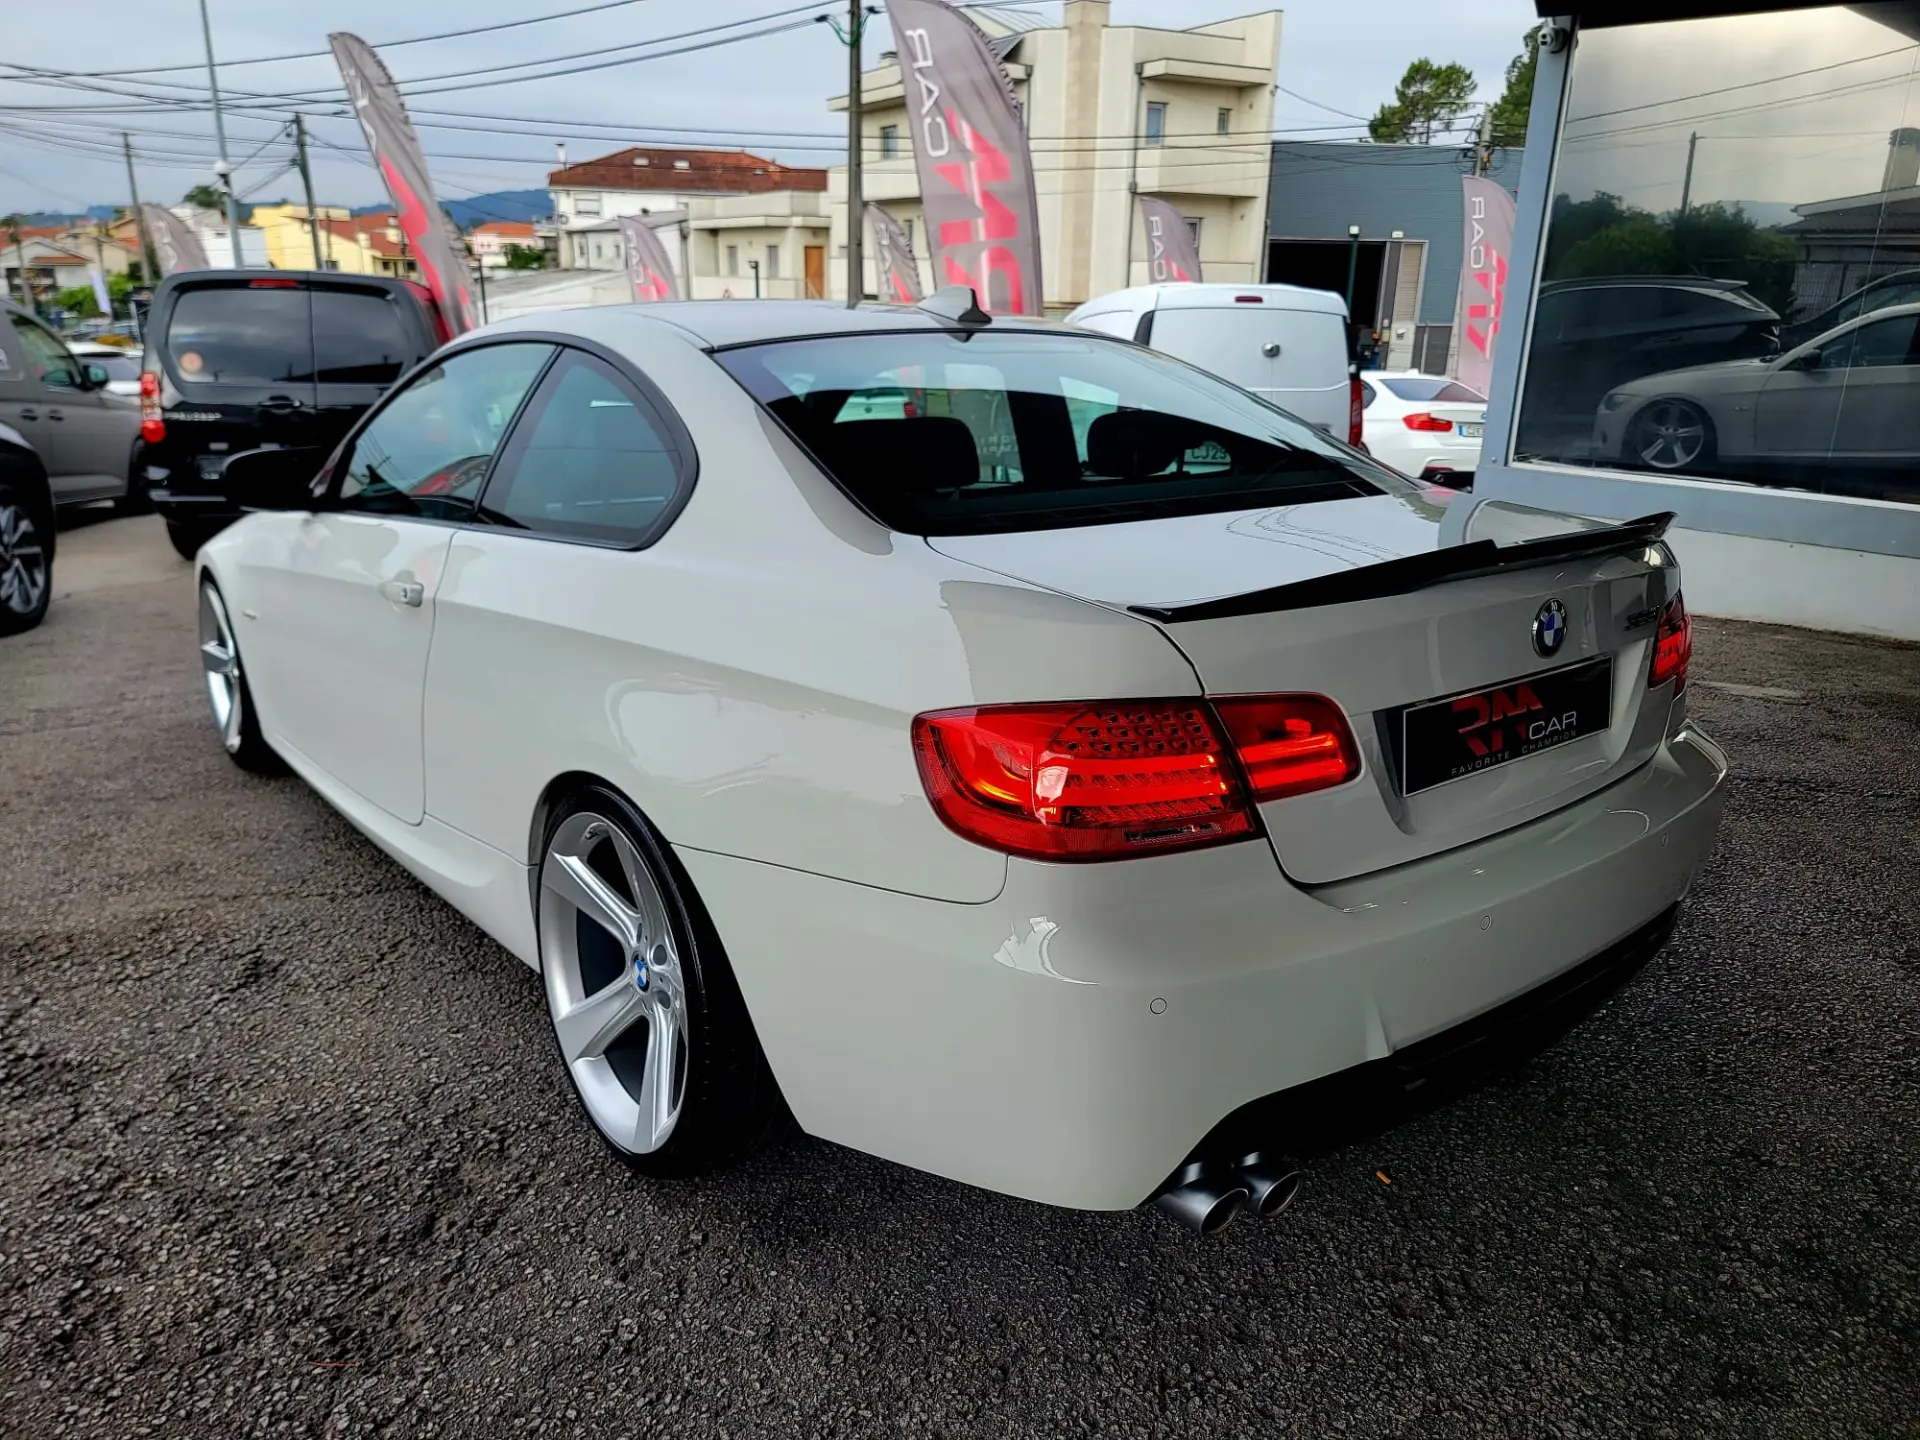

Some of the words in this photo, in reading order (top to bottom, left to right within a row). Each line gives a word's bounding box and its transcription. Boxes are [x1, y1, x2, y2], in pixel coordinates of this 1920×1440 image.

[1452, 684, 1543, 756] RM
[1529, 710, 1577, 740] CAR
[1450, 750, 1511, 776] FAVORITE
[1521, 729, 1577, 754] CHAMPION
